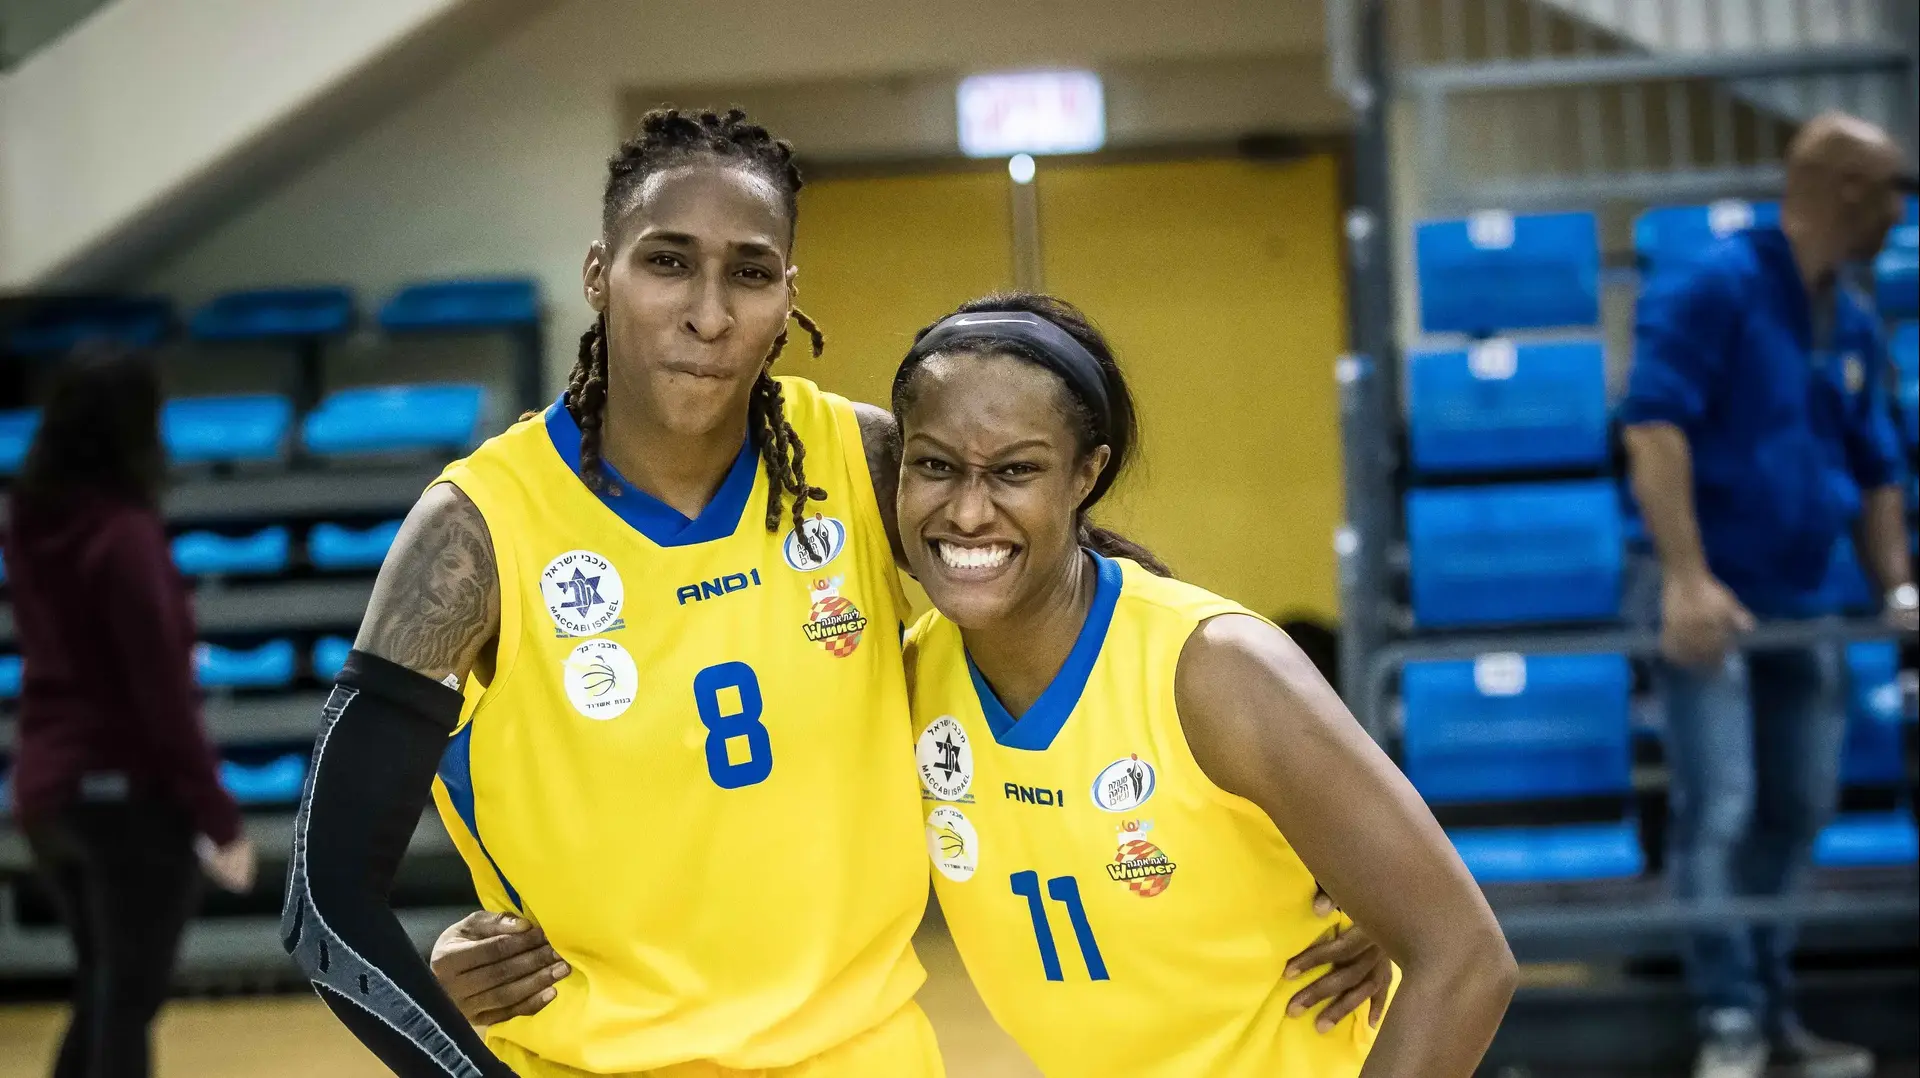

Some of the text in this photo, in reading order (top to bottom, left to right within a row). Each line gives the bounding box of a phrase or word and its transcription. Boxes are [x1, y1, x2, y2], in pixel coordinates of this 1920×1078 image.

[545, 554, 608, 578] מכבי ישראל
[550, 605, 591, 632] MACCABI
[592, 599, 619, 630] ISRAEL
[803, 618, 867, 641] Winner
[693, 661, 773, 789] 8
[927, 719, 966, 743] מכבי ישראל
[922, 764, 951, 796] MACCABI
[951, 774, 970, 796] ISRAEL
[1106, 863, 1176, 881] Winner
[1010, 870, 1110, 981] 11
